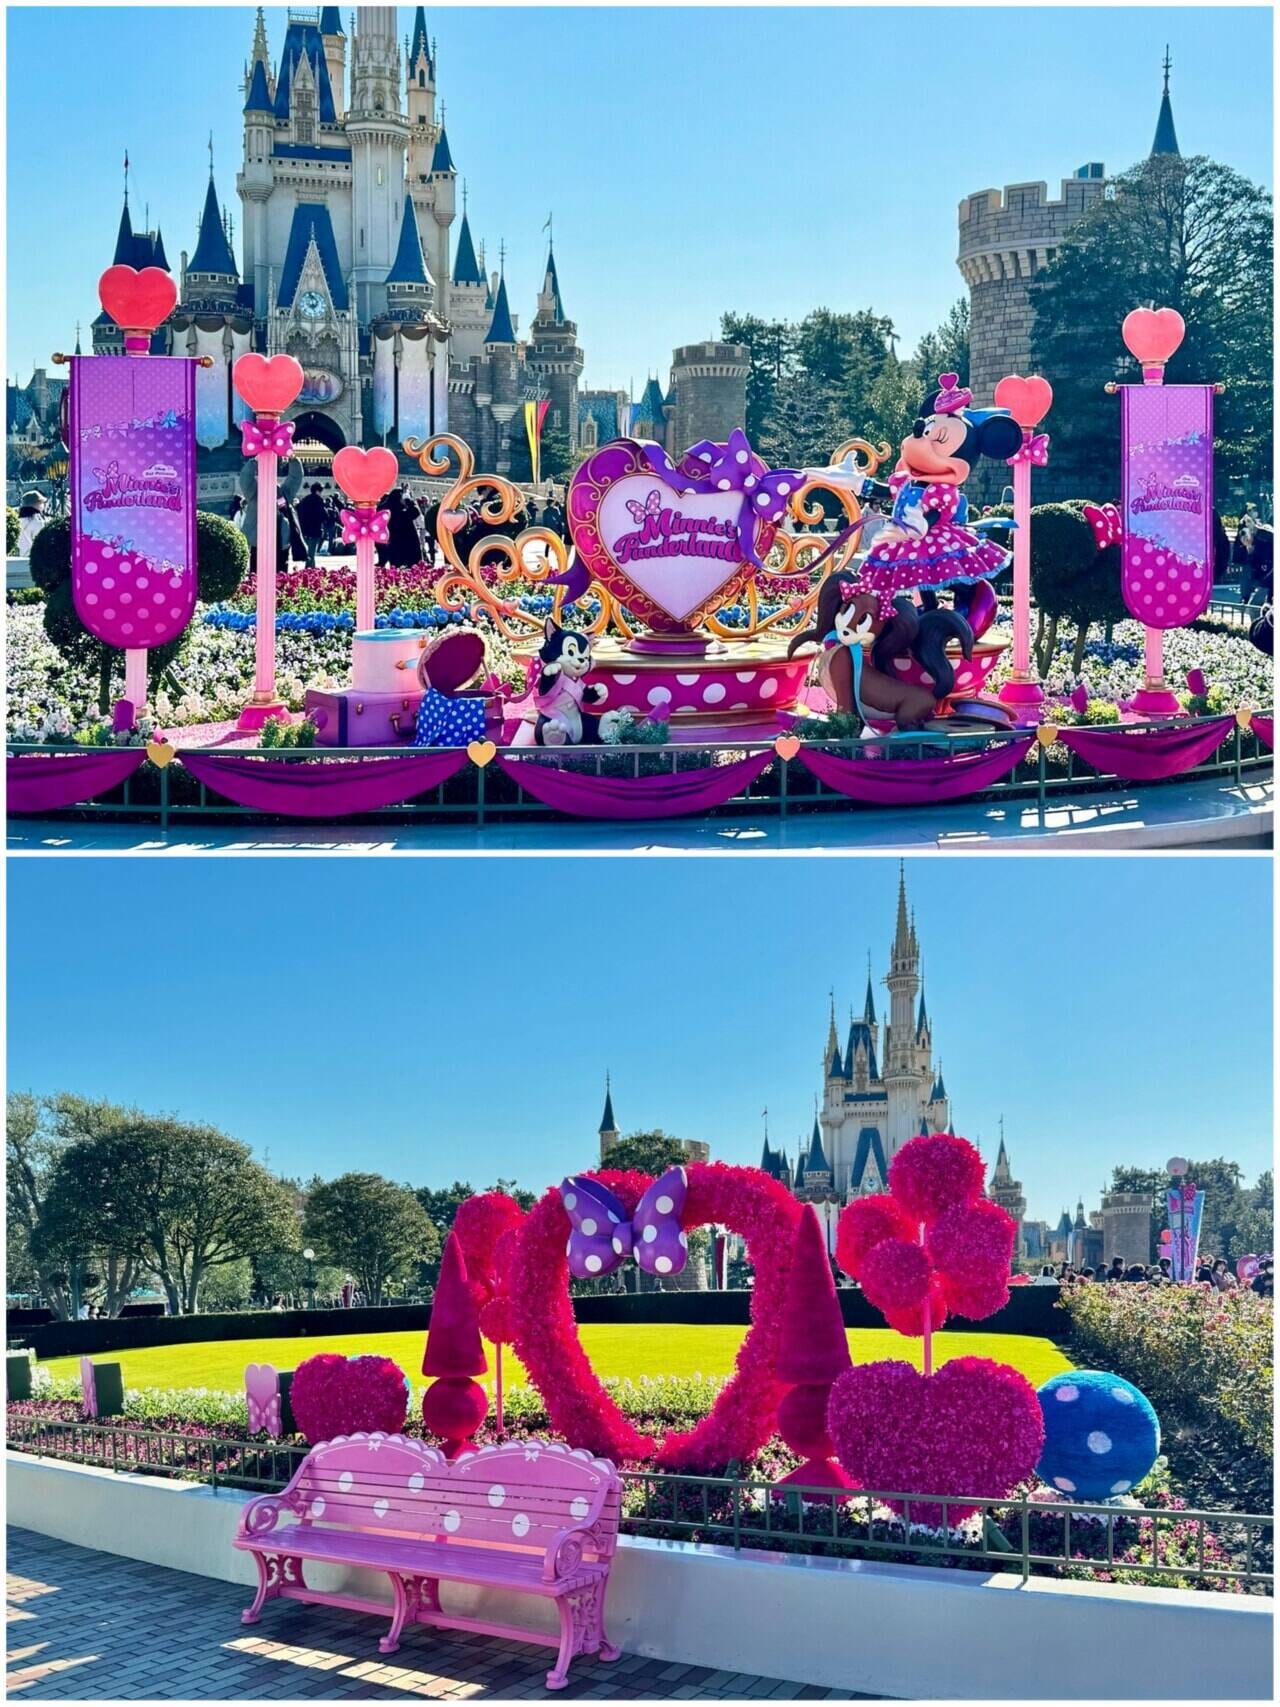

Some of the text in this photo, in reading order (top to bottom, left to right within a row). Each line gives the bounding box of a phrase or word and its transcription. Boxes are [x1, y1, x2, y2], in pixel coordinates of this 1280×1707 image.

[102, 473, 179, 498] Minnie's
[639, 508, 738, 545] Minnie's
[613, 531, 744, 563] Funderland
